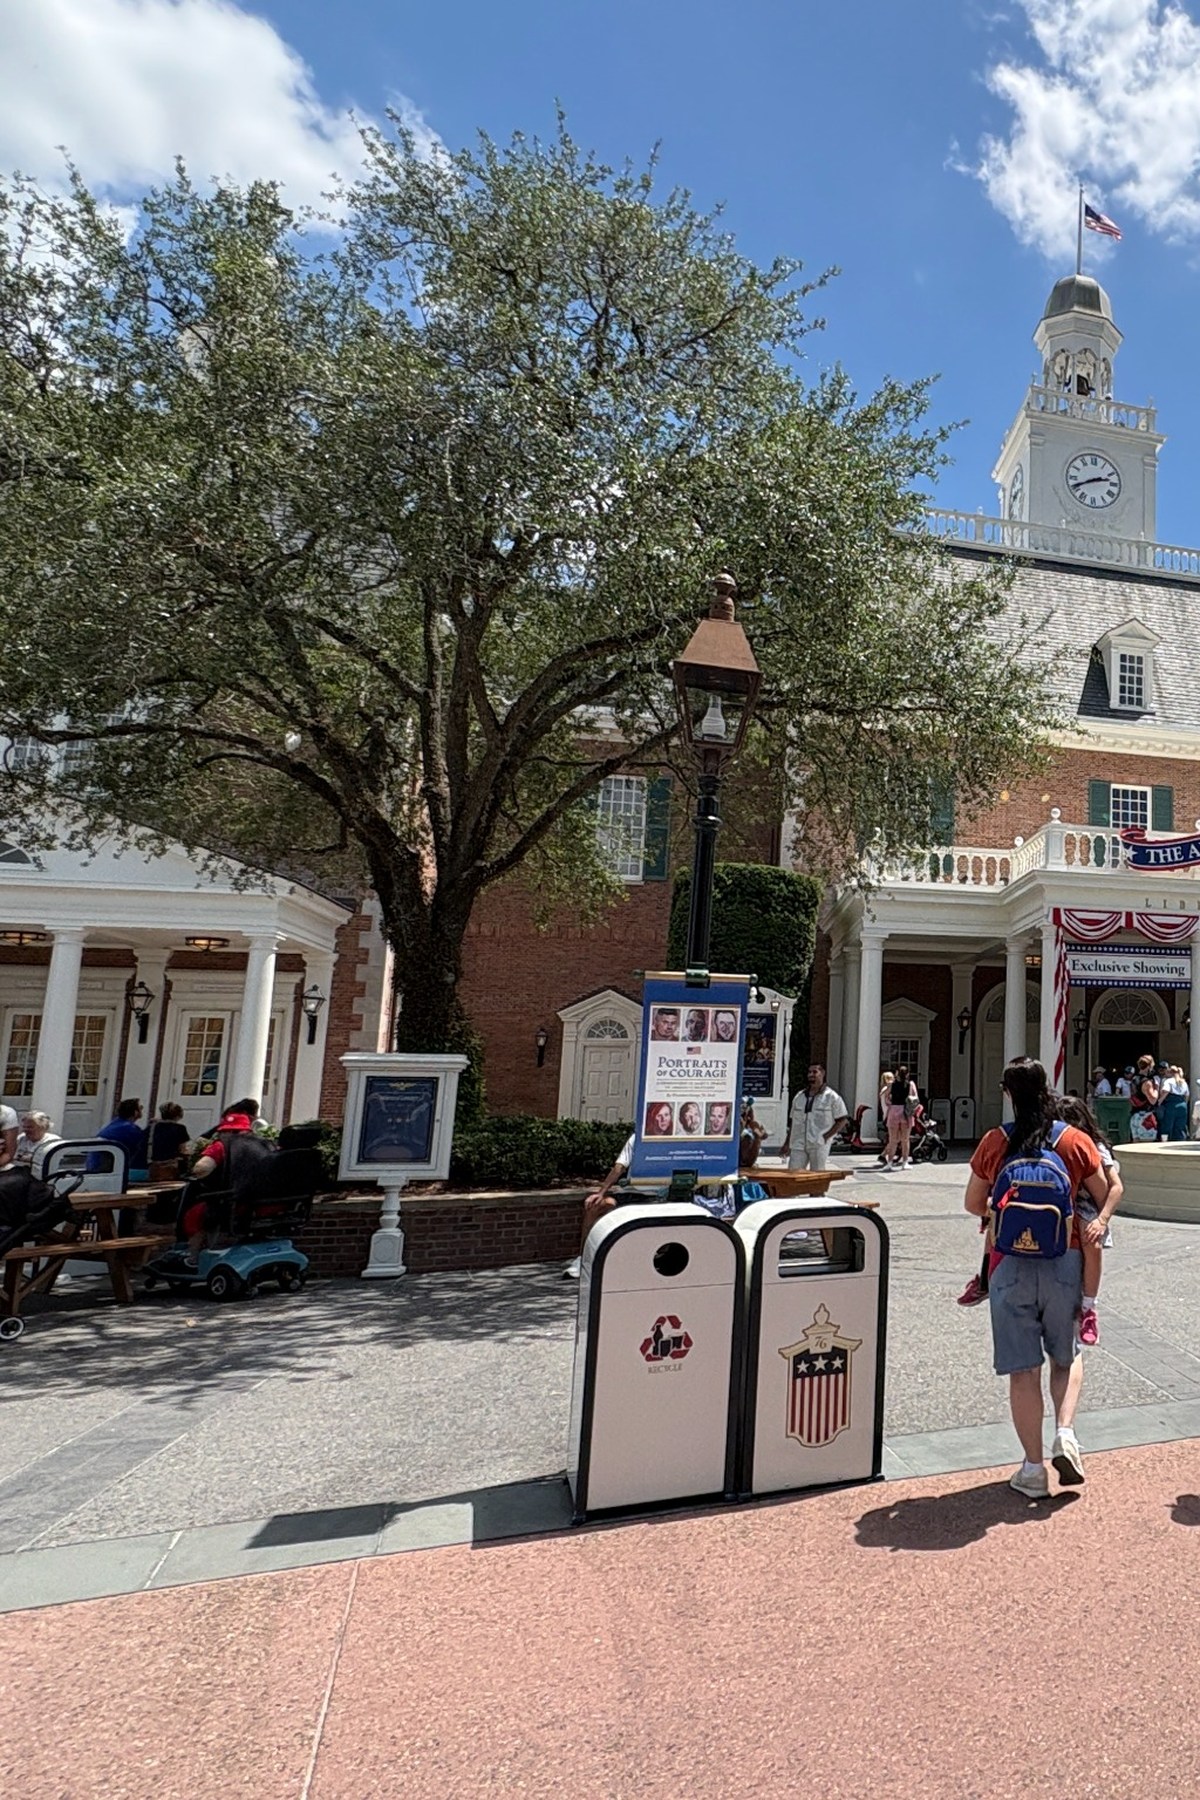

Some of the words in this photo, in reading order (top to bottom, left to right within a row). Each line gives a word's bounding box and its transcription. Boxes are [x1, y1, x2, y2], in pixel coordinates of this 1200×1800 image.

[1146, 846, 1183, 864] THE
[1071, 959, 1131, 973] Exclusive
[1133, 961, 1186, 977] Showing
[658, 1056, 727, 1069] PORTRAITS
[669, 1069, 727, 1078] COURAGE
[815, 1336, 827, 1349] 76
